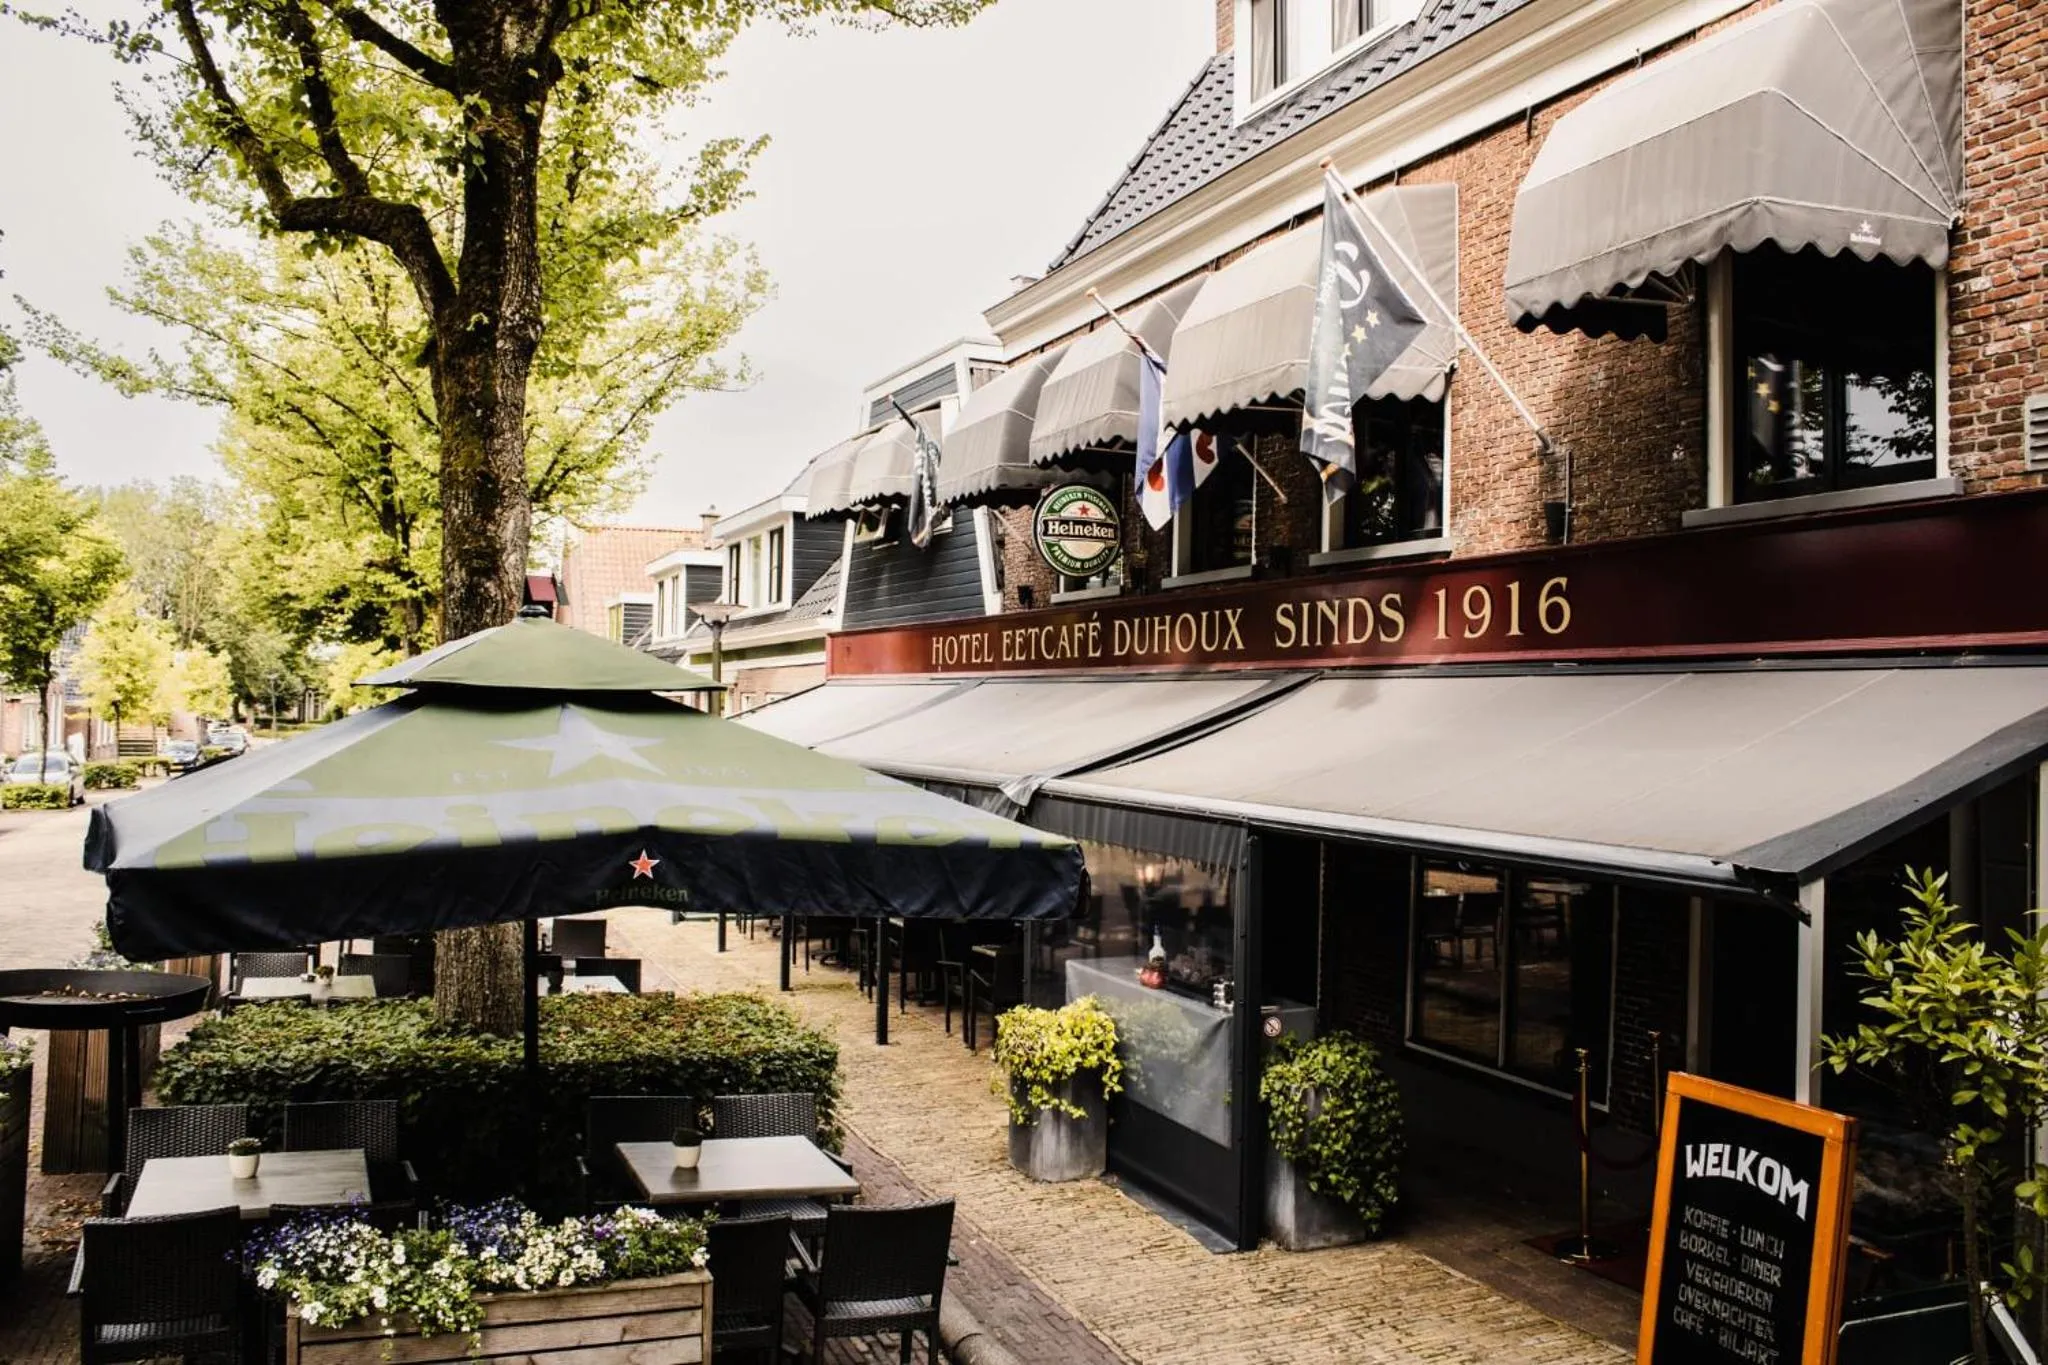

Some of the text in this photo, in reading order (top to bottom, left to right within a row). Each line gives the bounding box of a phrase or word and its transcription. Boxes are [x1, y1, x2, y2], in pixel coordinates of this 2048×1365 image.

[1047, 520, 1115, 539] Heineken
[931, 576, 1572, 666] HOTEL EETCAFÉ DUHOUX SINDS 1916
[1684, 1143, 1810, 1221] WELKOM
[1678, 1229, 1782, 1288] BORREL DINER
[1683, 1204, 1785, 1260] KOFFIE LUNCH
[1677, 1283, 1776, 1343] OVERNACHTEN
[1685, 1259, 1774, 1313] VERGADEREN
